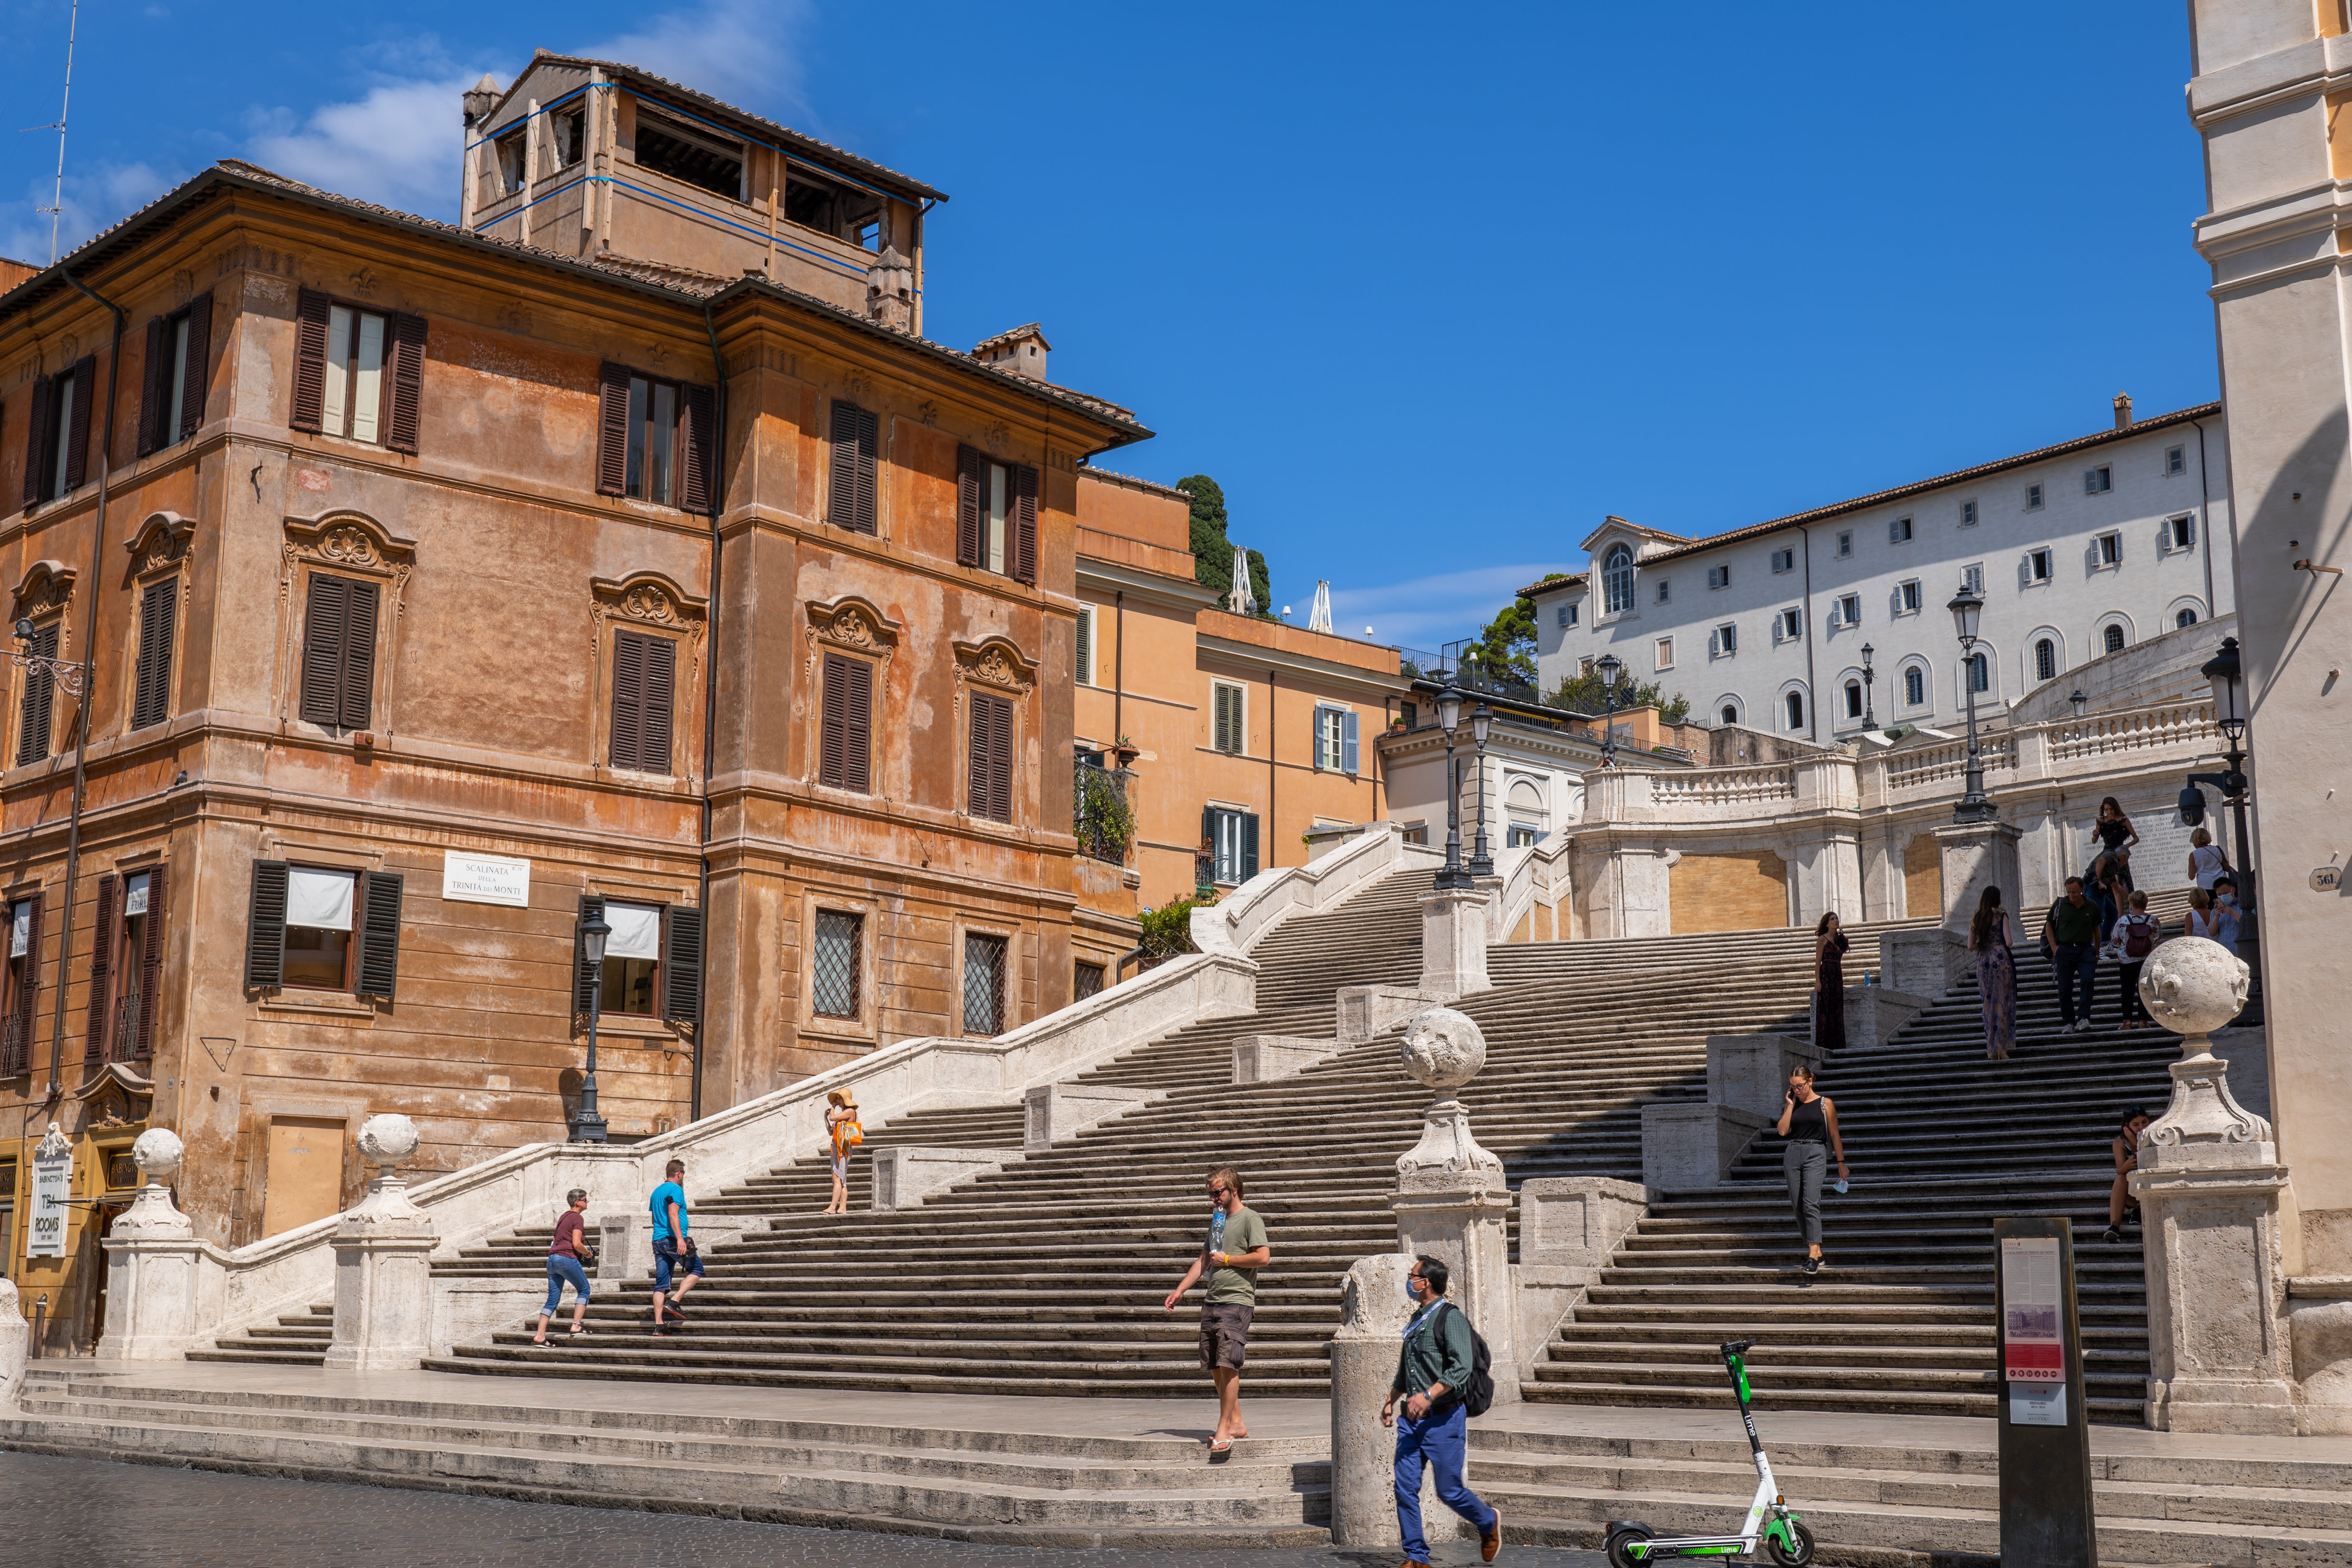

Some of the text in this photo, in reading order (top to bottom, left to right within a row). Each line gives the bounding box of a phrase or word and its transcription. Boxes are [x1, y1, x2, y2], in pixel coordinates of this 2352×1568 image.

[466, 864, 509, 875] SCALINATA
[494, 885, 520, 895] MONTI
[131, 898, 148, 910] FURL
[15, 943, 26, 952] FUR
[112, 1162, 138, 1174] BABINGTO
[39, 1172, 63, 1184] BABINGTON'S
[42, 1194, 56, 1210] TEA
[35, 1217, 59, 1233] ROOMS
[1744, 1415, 1756, 1437] Lime
